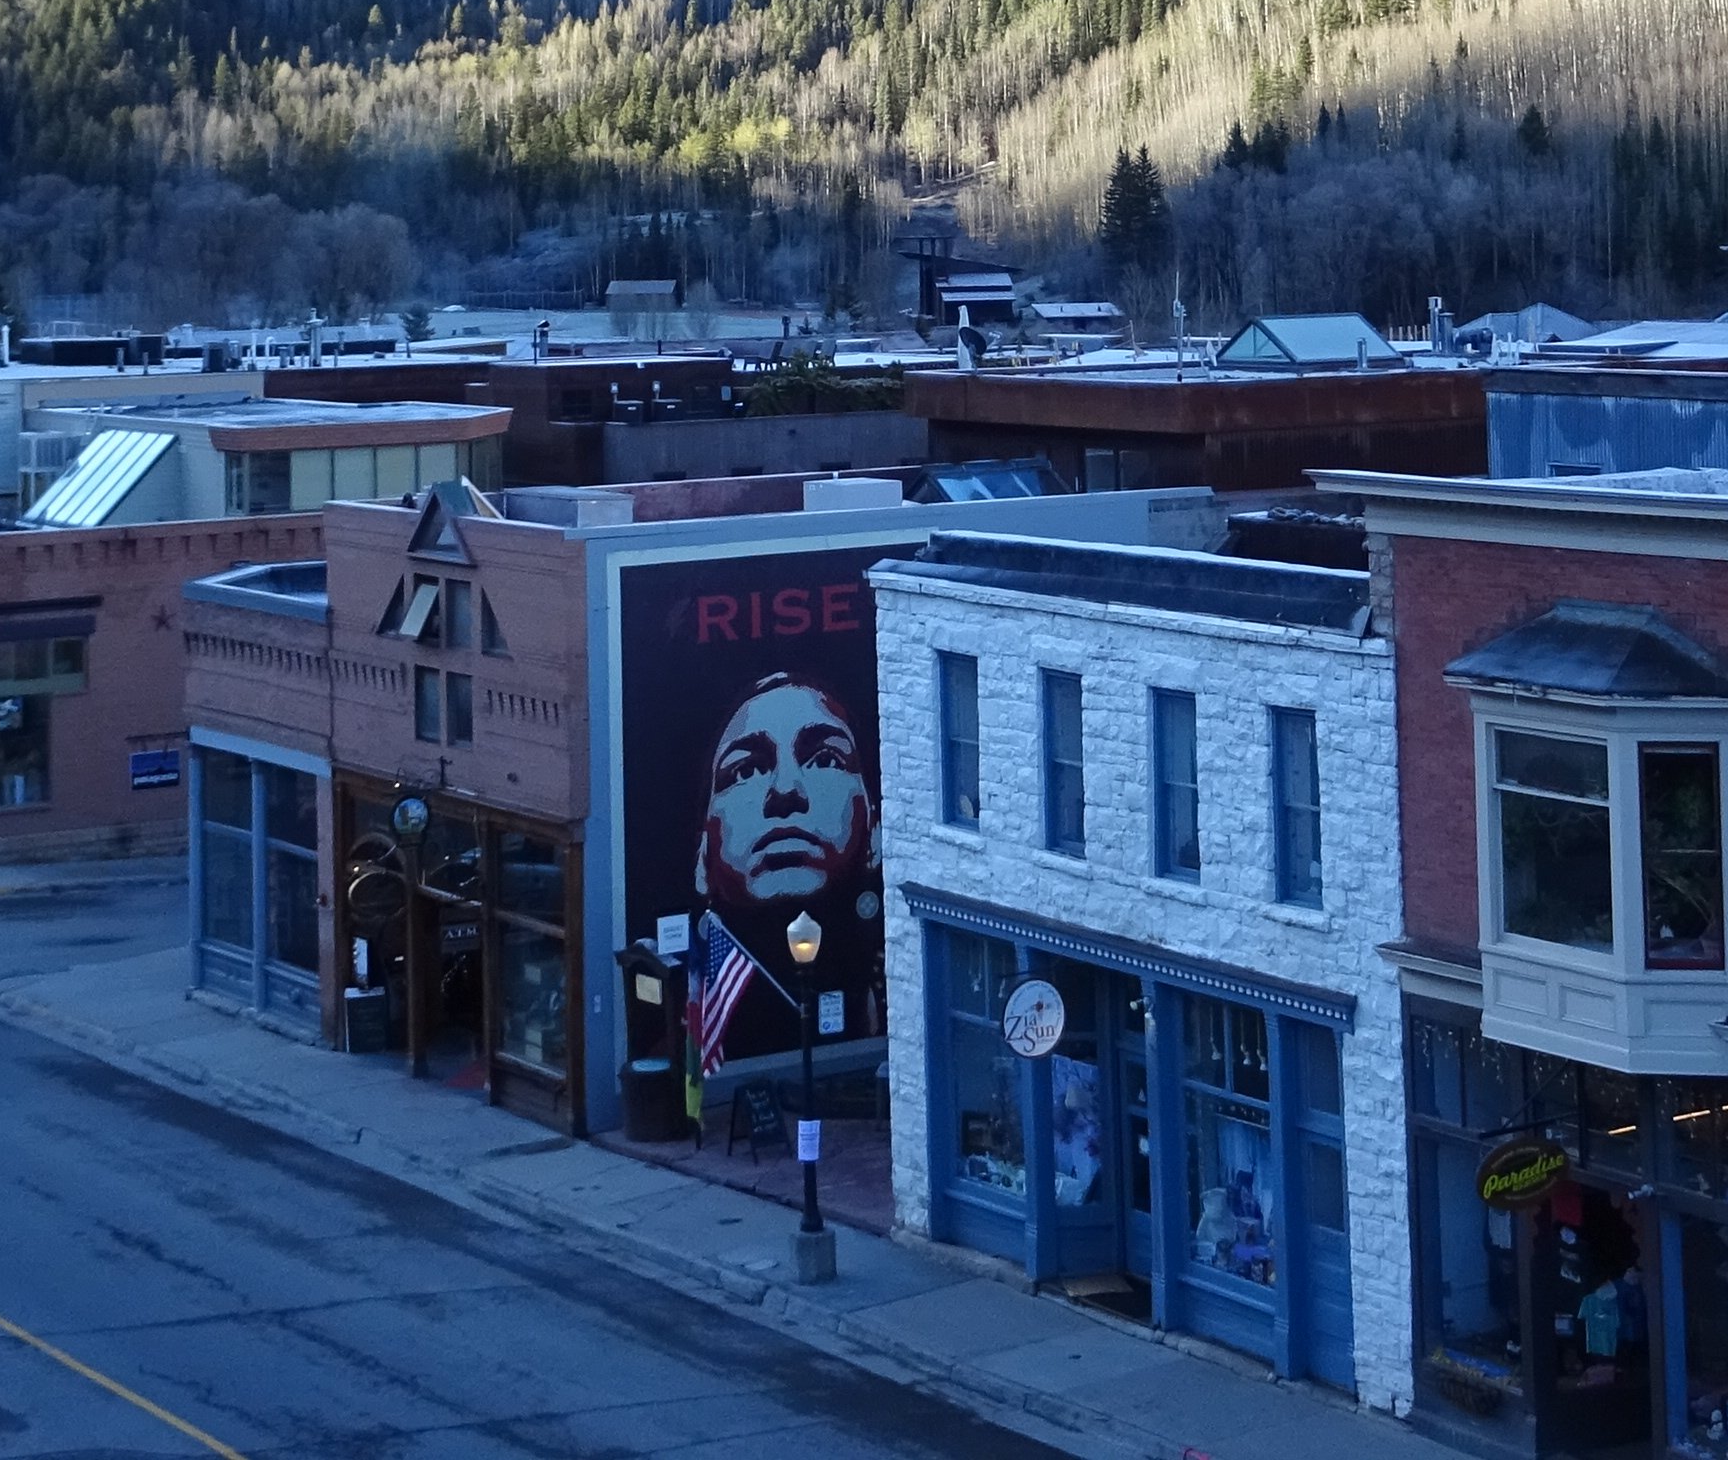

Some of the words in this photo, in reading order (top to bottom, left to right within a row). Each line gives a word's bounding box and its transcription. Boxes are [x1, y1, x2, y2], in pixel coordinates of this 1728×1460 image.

[697, 583, 860, 644] RISE
[1006, 1010, 1037, 1041] Zia
[1023, 1025, 1055, 1053] Sun
[1483, 1153, 1564, 1199] Paradise
